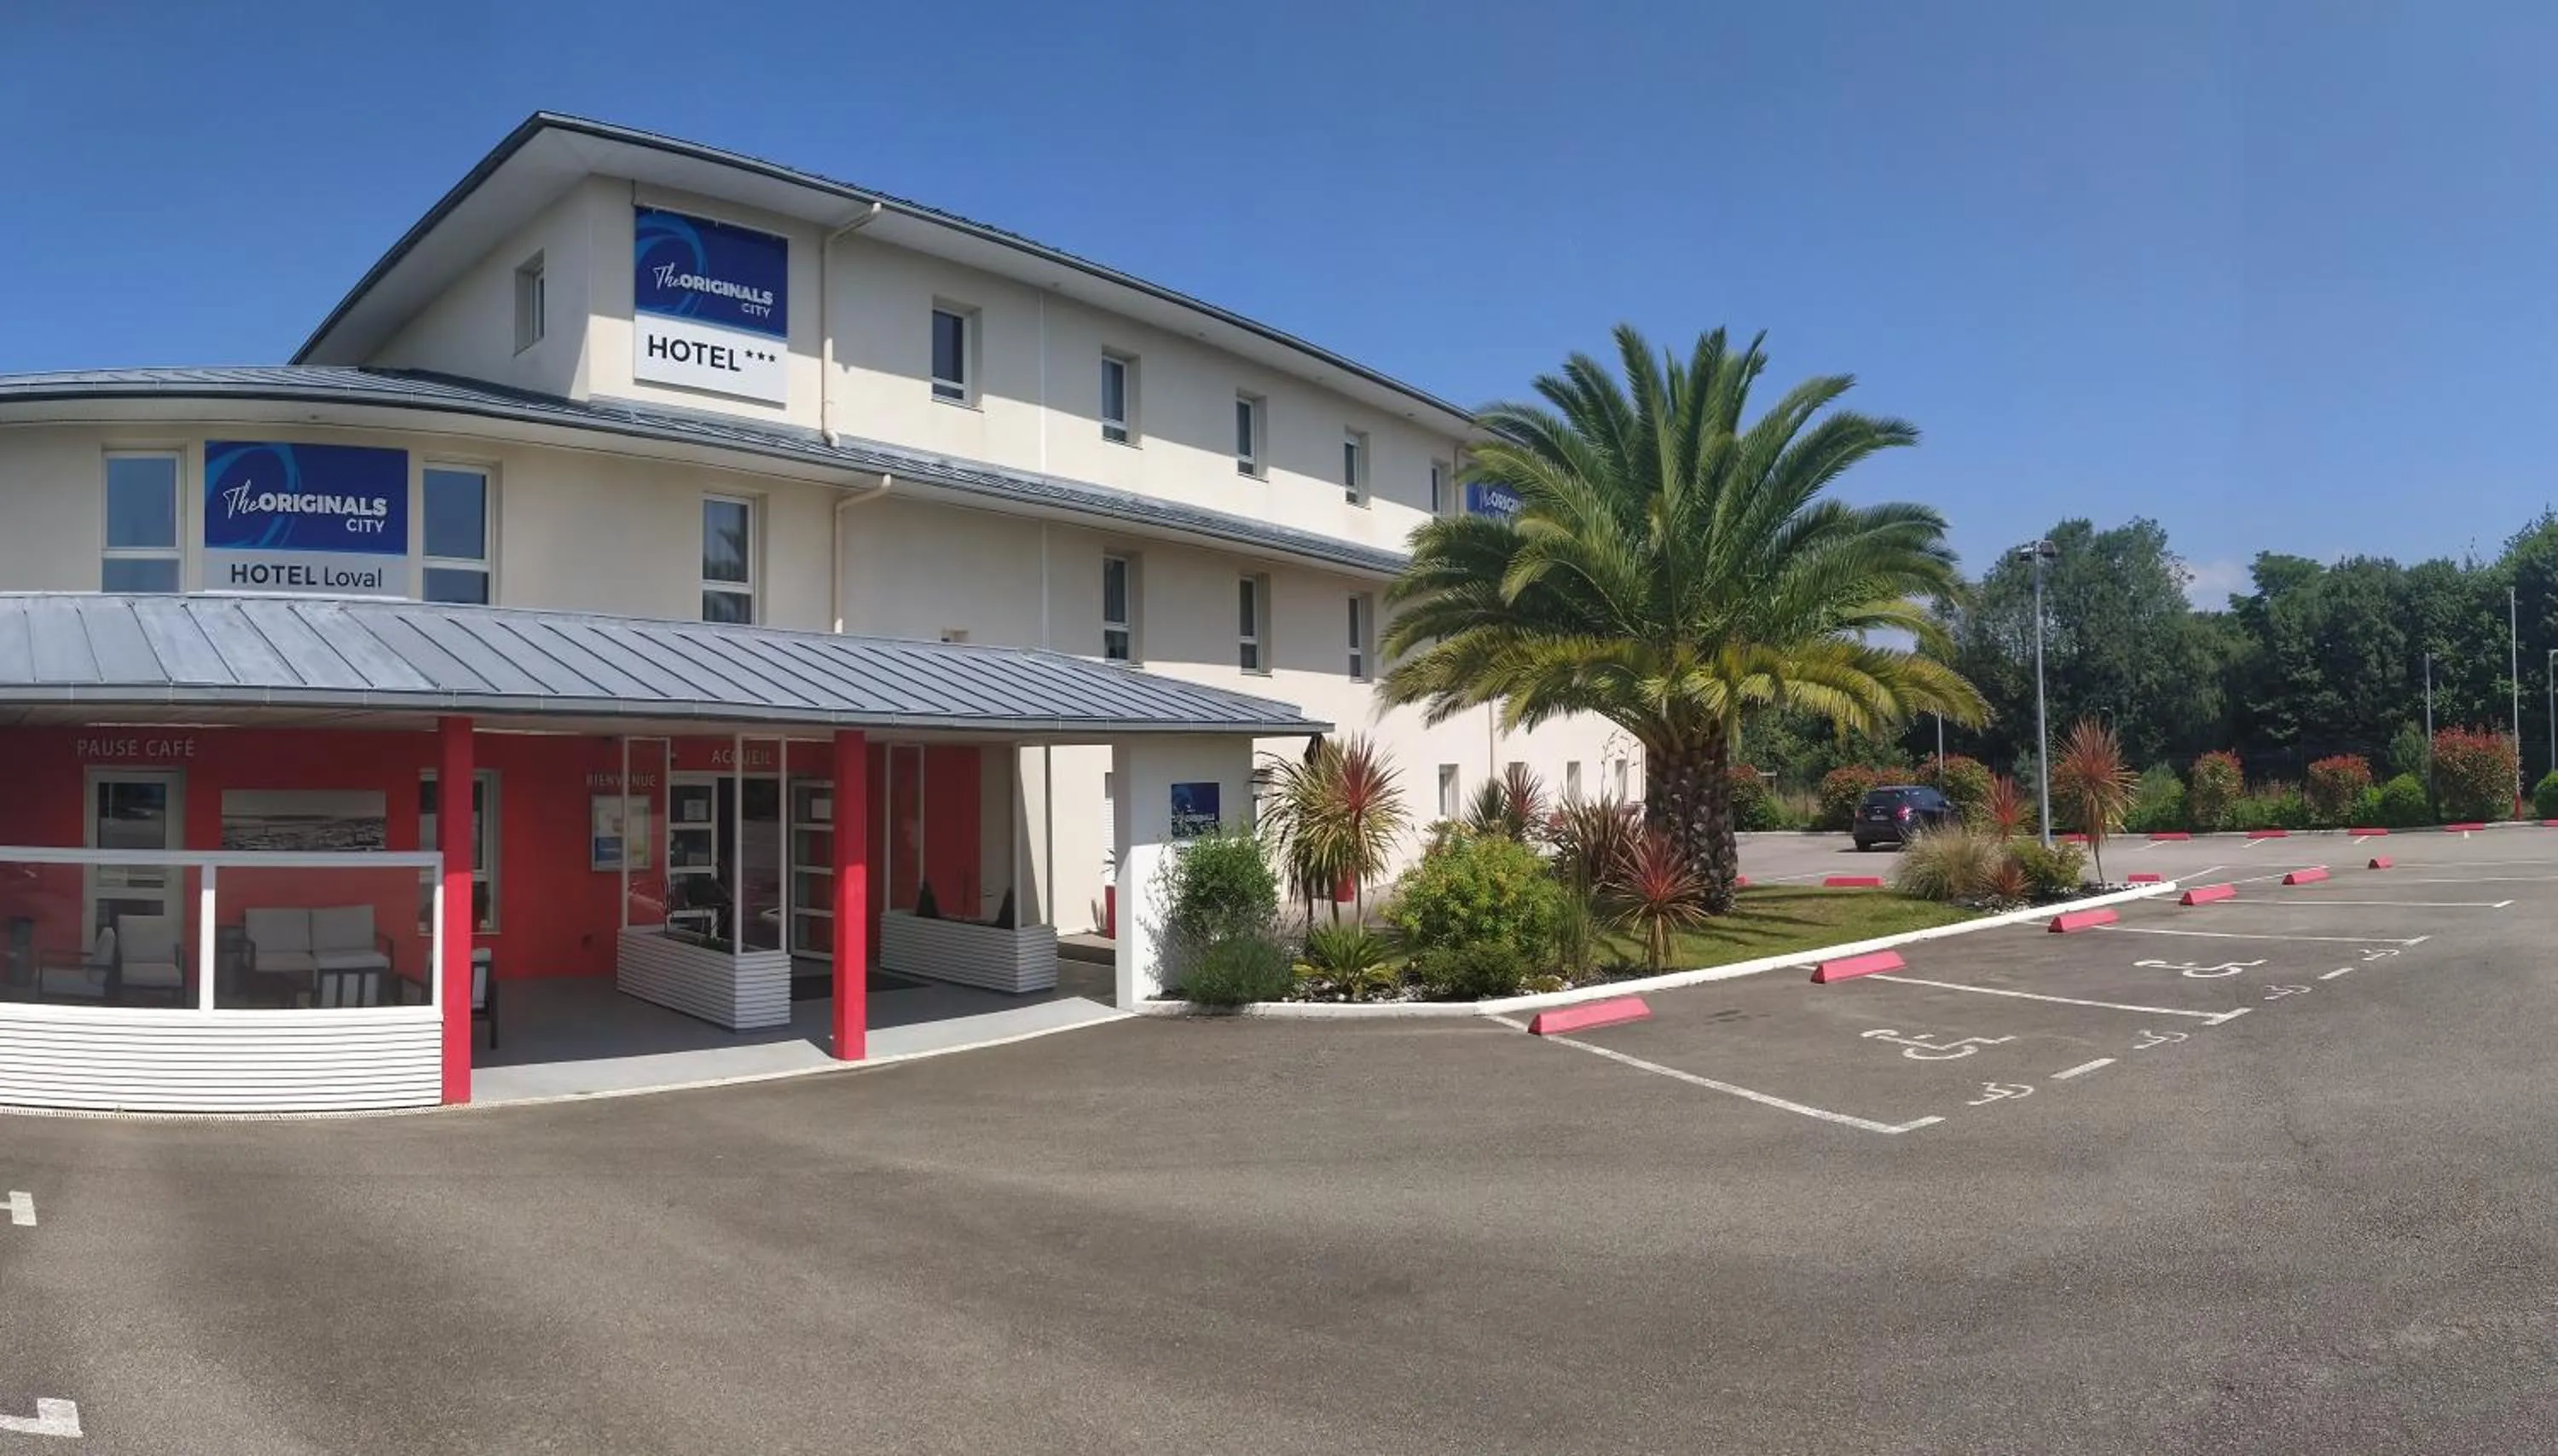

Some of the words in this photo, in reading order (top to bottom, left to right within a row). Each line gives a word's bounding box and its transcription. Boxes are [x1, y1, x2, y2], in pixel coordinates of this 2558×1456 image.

[680, 274, 774, 306] ORIGINALS
[741, 303, 772, 318] CITY
[648, 334, 742, 372] HOTEL
[258, 492, 388, 517] ORIGINALS
[345, 518, 385, 533] CITY
[230, 563, 317, 586] HOTEL
[324, 567, 382, 588] Loval
[77, 738, 138, 757] PAUSE
[146, 736, 196, 757] CAFÉ
[586, 772, 657, 788] BIENVNUE
